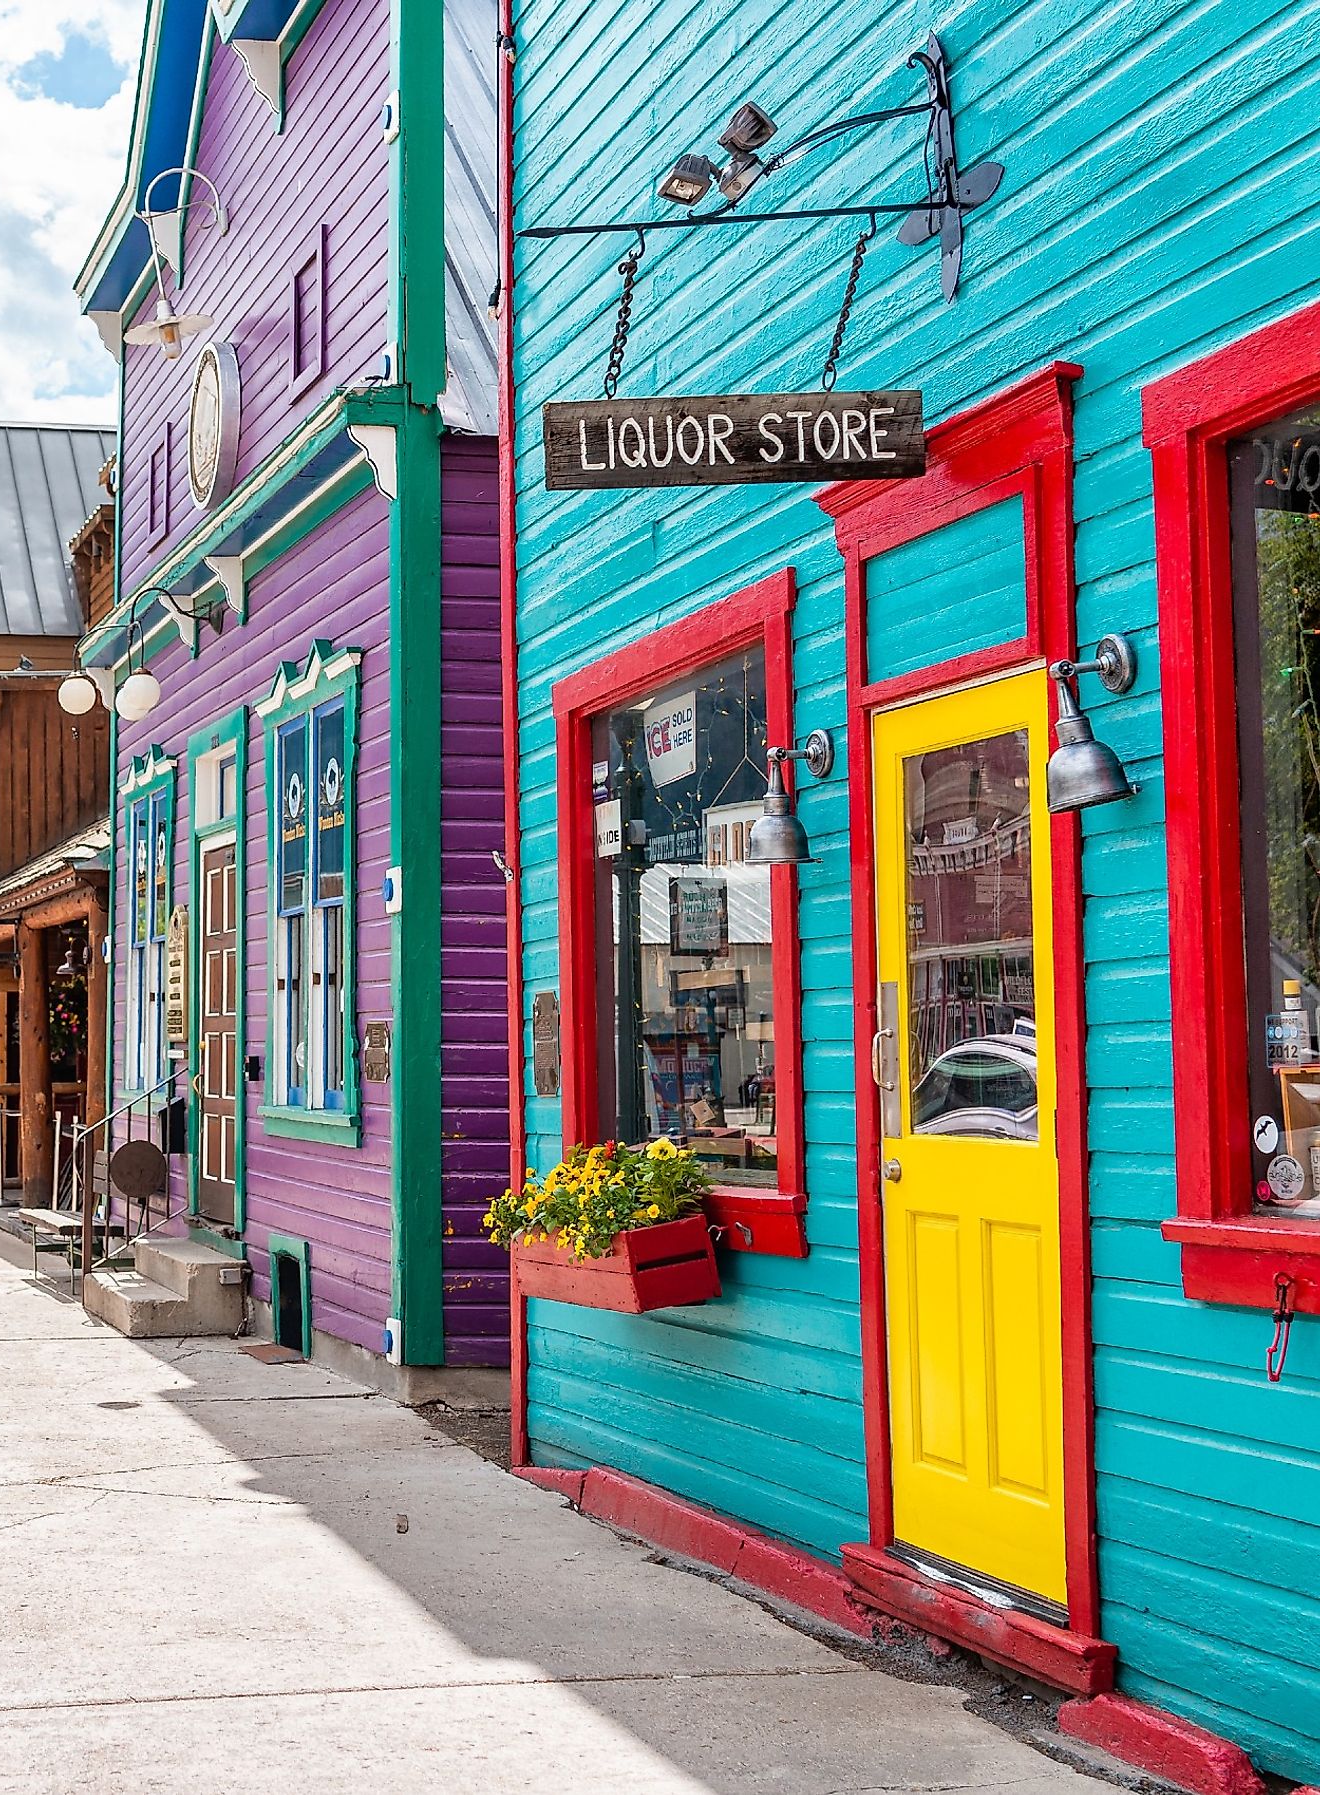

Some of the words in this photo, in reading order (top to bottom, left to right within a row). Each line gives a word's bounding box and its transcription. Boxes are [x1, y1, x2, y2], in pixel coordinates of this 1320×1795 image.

[579, 413, 735, 471] LIQUOR
[758, 407, 897, 463] STORE
[672, 707, 693, 727] SOLD
[647, 716, 671, 759] ICE
[673, 728, 693, 748] HERE
[1268, 1044, 1299, 1060] 2012
